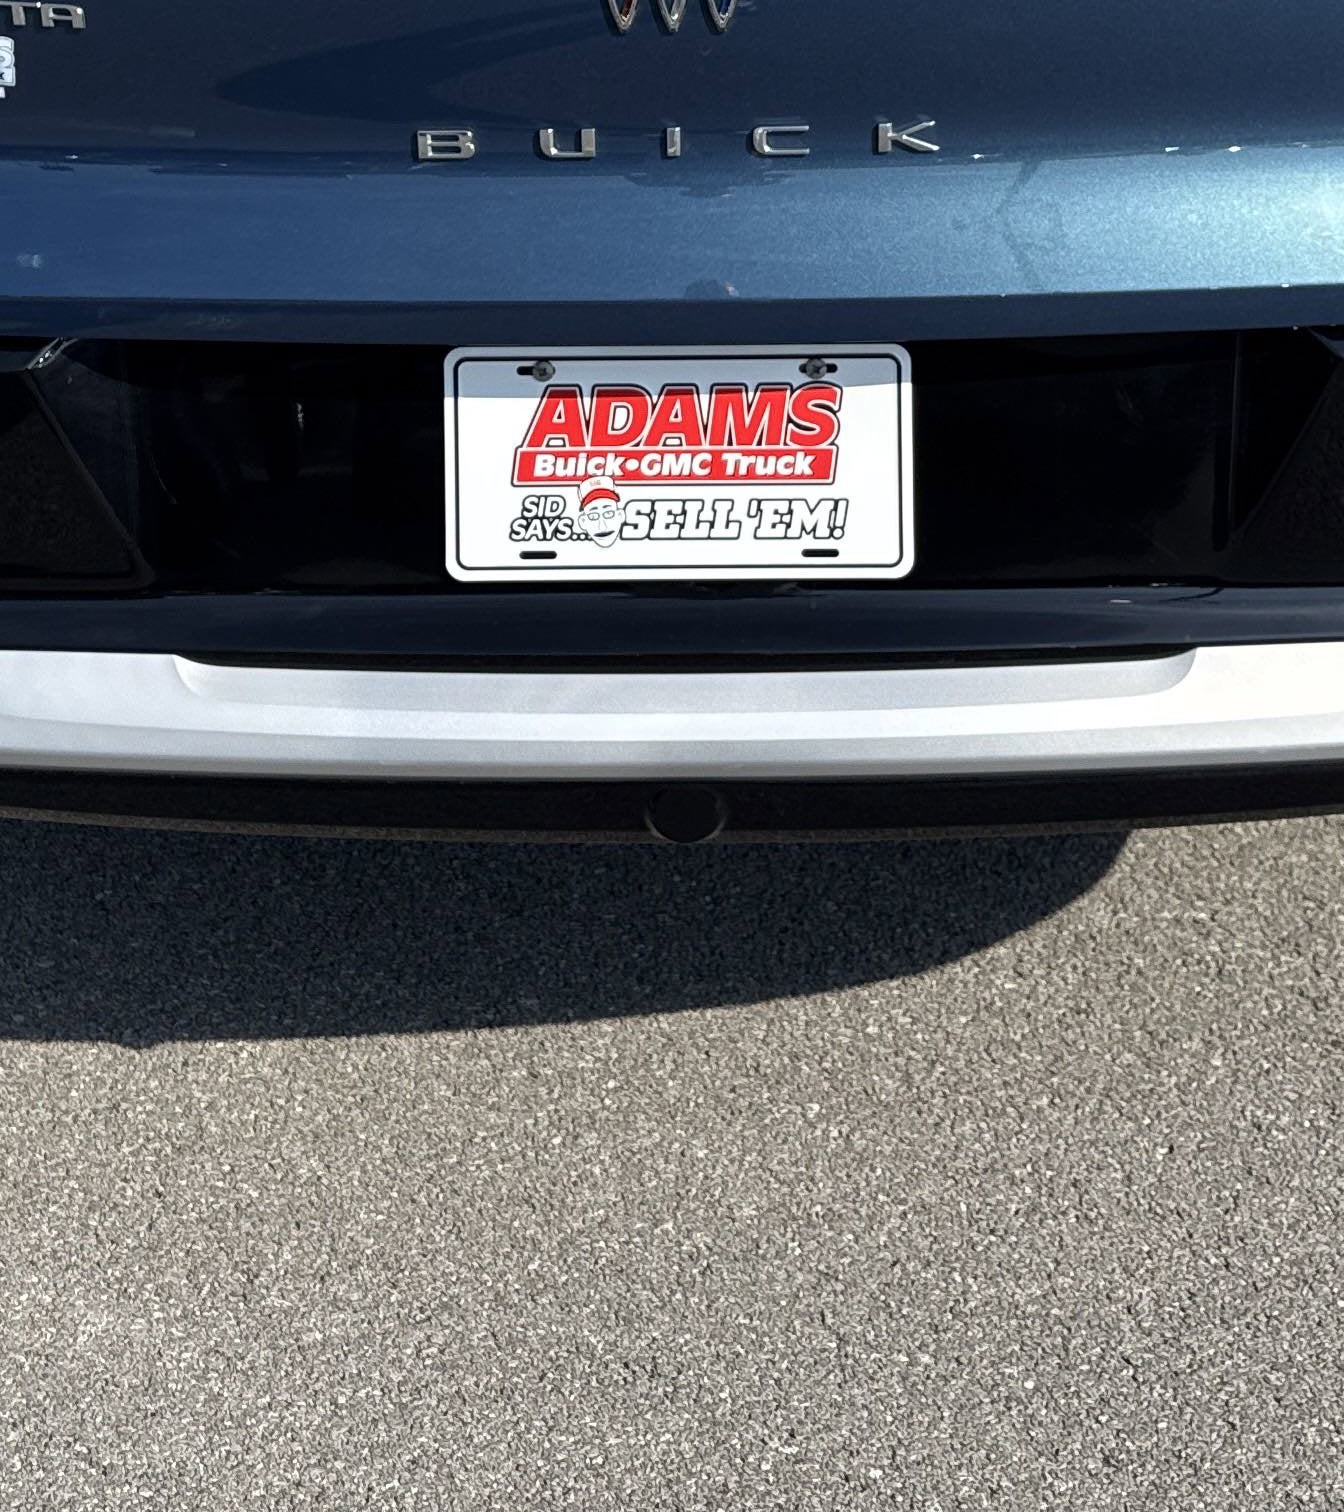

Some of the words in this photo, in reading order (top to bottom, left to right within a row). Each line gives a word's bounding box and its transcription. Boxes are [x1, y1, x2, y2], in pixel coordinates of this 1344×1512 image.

[416, 120, 941, 161] BUICK
[522, 382, 843, 449] ADAMS
[722, 450, 817, 477] Truck
[522, 495, 567, 519] SID
[620, 498, 744, 541] SELL
[747, 497, 850, 541] 'EM!
